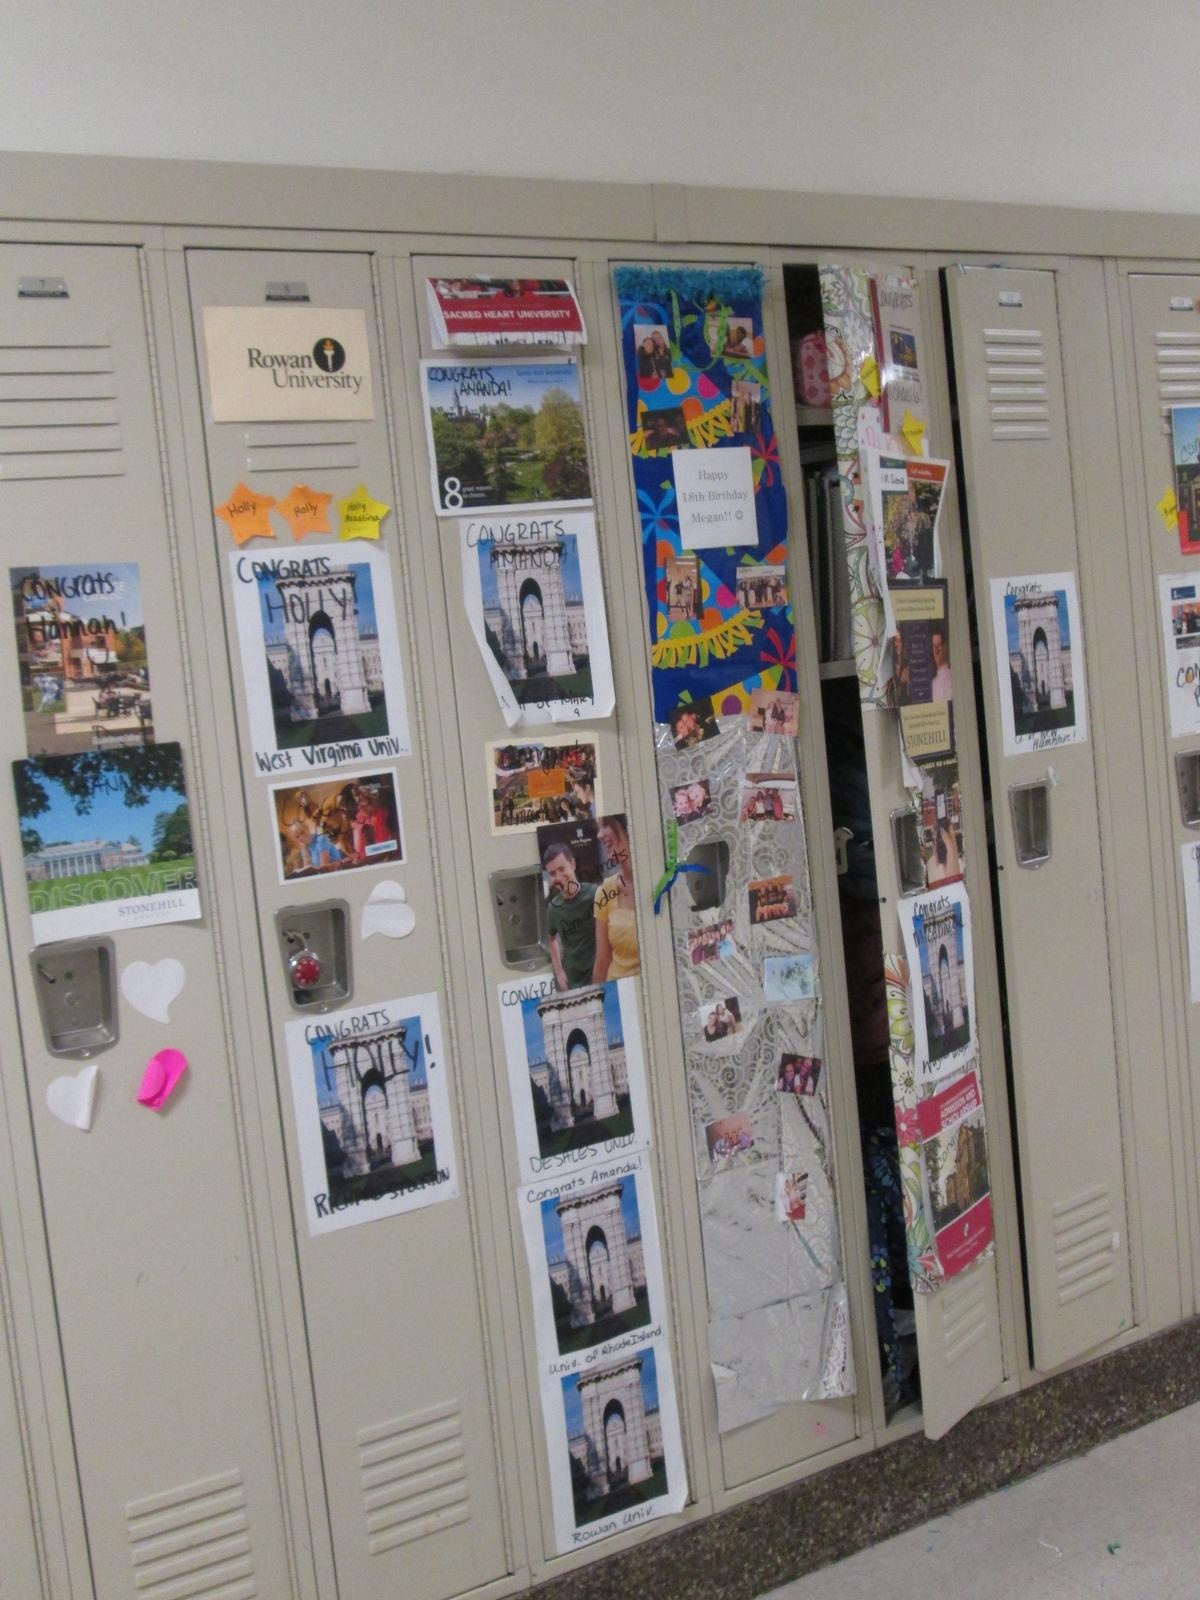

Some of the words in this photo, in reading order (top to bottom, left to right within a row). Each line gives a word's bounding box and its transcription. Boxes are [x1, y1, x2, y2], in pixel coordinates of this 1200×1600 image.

[443, 309, 482, 319] SACRED
[484, 309, 515, 319] HEART
[517, 309, 571, 319] UNIVERSITY
[247, 347, 313, 368] Rowan
[272, 368, 362, 394] University
[428, 366, 496, 382] CONGRATS
[698, 470, 729, 481] Happy
[444, 476, 463, 509] 8
[683, 490, 705, 503] 18th
[708, 489, 748, 502] Birthday
[226, 502, 258, 518] Holly
[294, 503, 319, 517] Holly
[691, 510, 731, 524] Megan!!
[466, 519, 566, 548] CONGRATS
[237, 556, 332, 584] CONGRATS
[255, 750, 293, 773] West
[302, 742, 363, 768] Virginia
[28, 866, 198, 913] DISCOVER
[117, 898, 187, 917] STONEHILL
[304, 1008, 391, 1047] CONGRATS
[320, 1033, 437, 1092] HOLLY!
[526, 1177, 586, 1203] Congrats
[590, 1156, 643, 1184] Amanda!
[585, 1349, 599, 1363] of
[571, 1521, 618, 1545] Rowan
